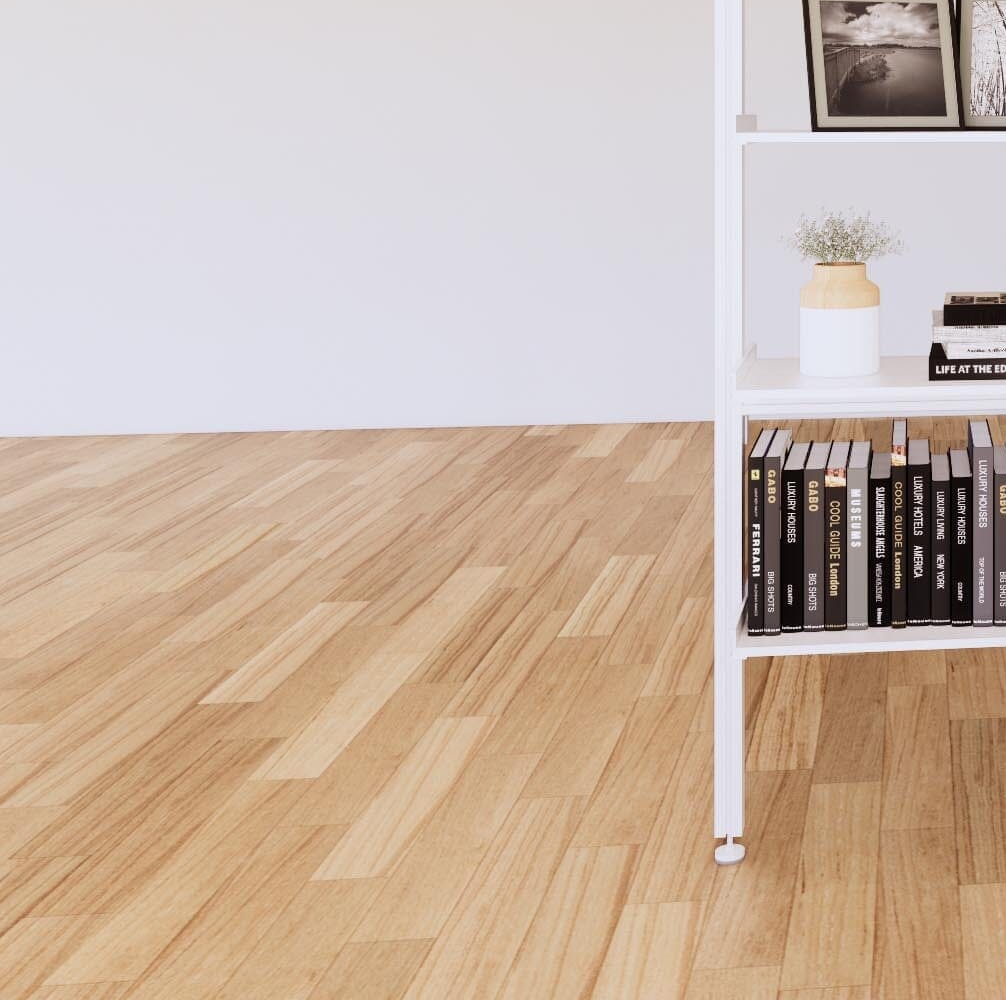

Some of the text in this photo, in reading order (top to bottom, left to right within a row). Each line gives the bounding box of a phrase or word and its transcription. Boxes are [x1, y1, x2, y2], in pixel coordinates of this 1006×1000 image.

[935, 365, 957, 374] LIFE
[958, 365, 971, 374] AT
[973, 365, 992, 373] THE
[787, 481, 796, 512] LUXURY
[978, 460, 988, 492] LUXURY
[851, 488, 862, 548] MUSEUMS
[957, 488, 966, 515] LUXURY
[978, 494, 988, 528] HOUSES
[767, 469, 777, 613] GABO BIG SHOTS
[787, 512, 796, 544] HOUSES
[809, 480, 819, 611] GABO BIG SHOTS
[830, 501, 841, 597] COOL GUIDE London
[875, 537, 886, 559] ANGELS
[894, 482, 903, 590] COOL GUIDE London
[913, 476, 923, 578] LUXURY HOTELS AMERICA
[936, 491, 945, 590] LUXURY LIVING NEW YORK
[957, 516, 966, 545] HOUSES
[752, 523, 760, 577] FERRARI
